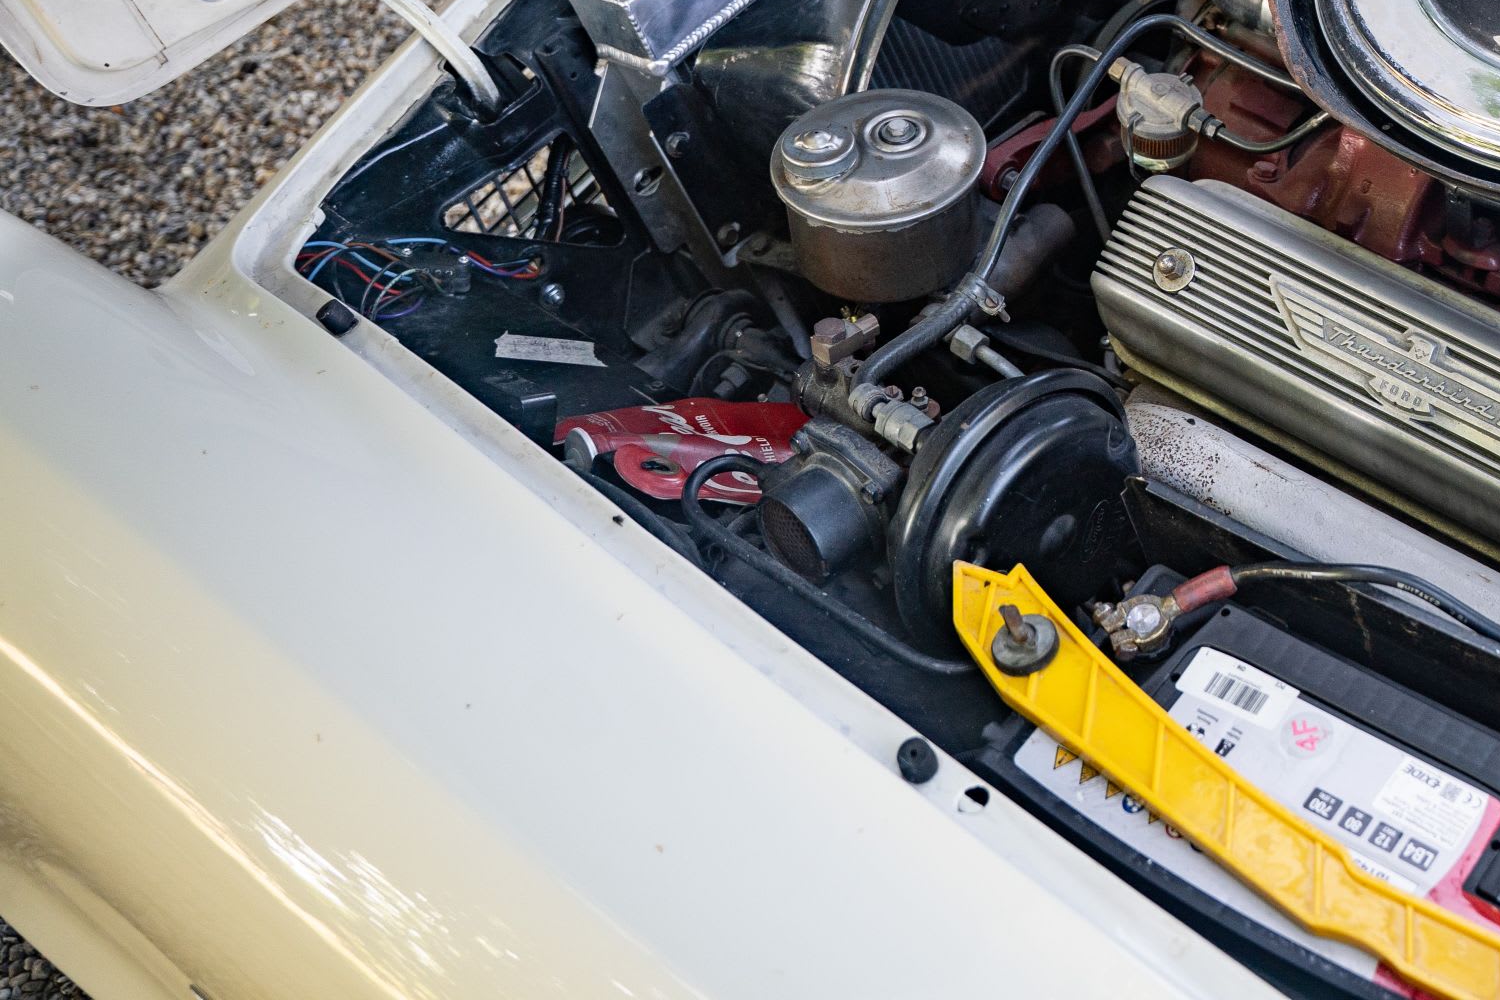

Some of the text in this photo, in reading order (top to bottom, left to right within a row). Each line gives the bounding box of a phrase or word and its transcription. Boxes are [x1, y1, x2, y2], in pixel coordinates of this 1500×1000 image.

[1329, 326, 1496, 420] Thunderbird
[1379, 378, 1423, 407] FORD
[755, 436, 777, 463] HIELD
[1403, 764, 1441, 789] EXIDE
[1308, 797, 1333, 818] 700
[1343, 815, 1364, 834] 80
[1374, 832, 1391, 849] 12
[1403, 844, 1435, 868] LB4
